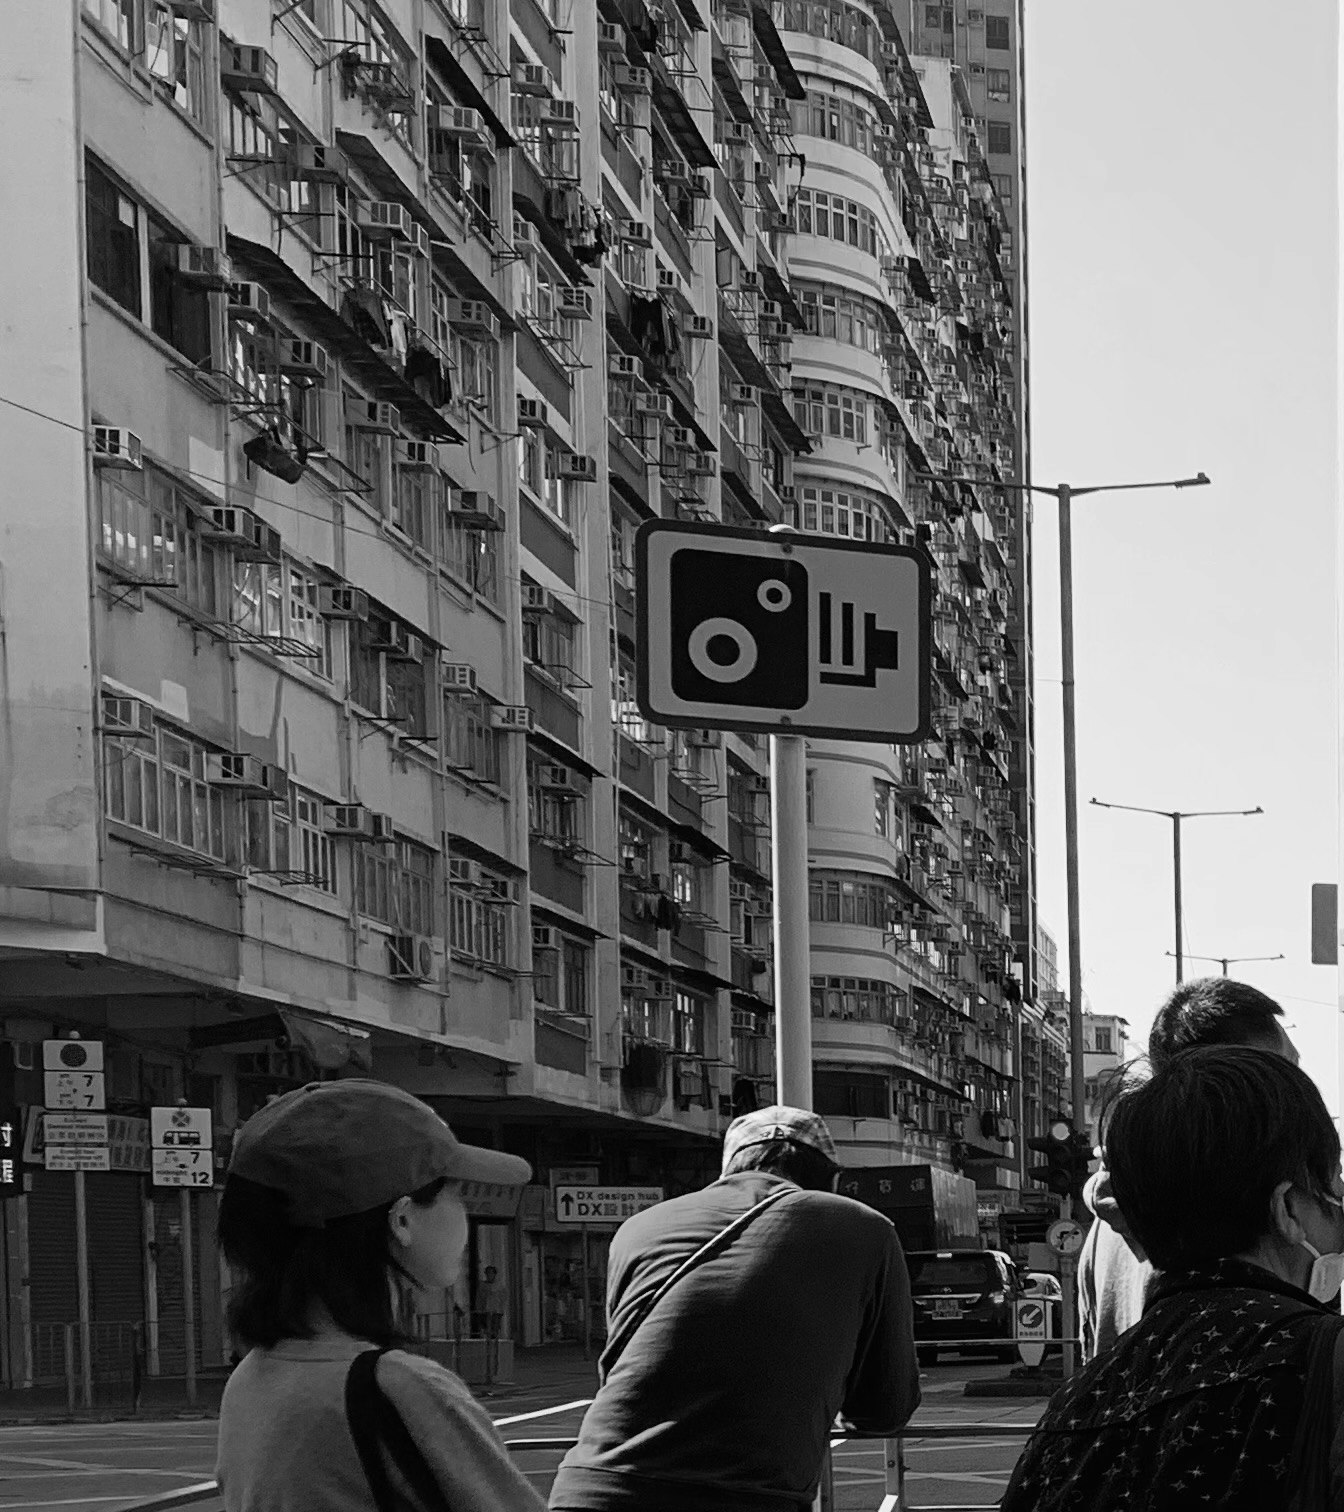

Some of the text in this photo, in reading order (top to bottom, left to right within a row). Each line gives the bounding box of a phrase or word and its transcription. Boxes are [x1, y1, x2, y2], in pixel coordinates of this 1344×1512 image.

[82, 1075, 93, 1087] 7
[84, 1095, 94, 1107] 7
[190, 1152, 200, 1164] 7
[191, 1172, 209, 1184] 12
[577, 1191, 593, 1200] DX
